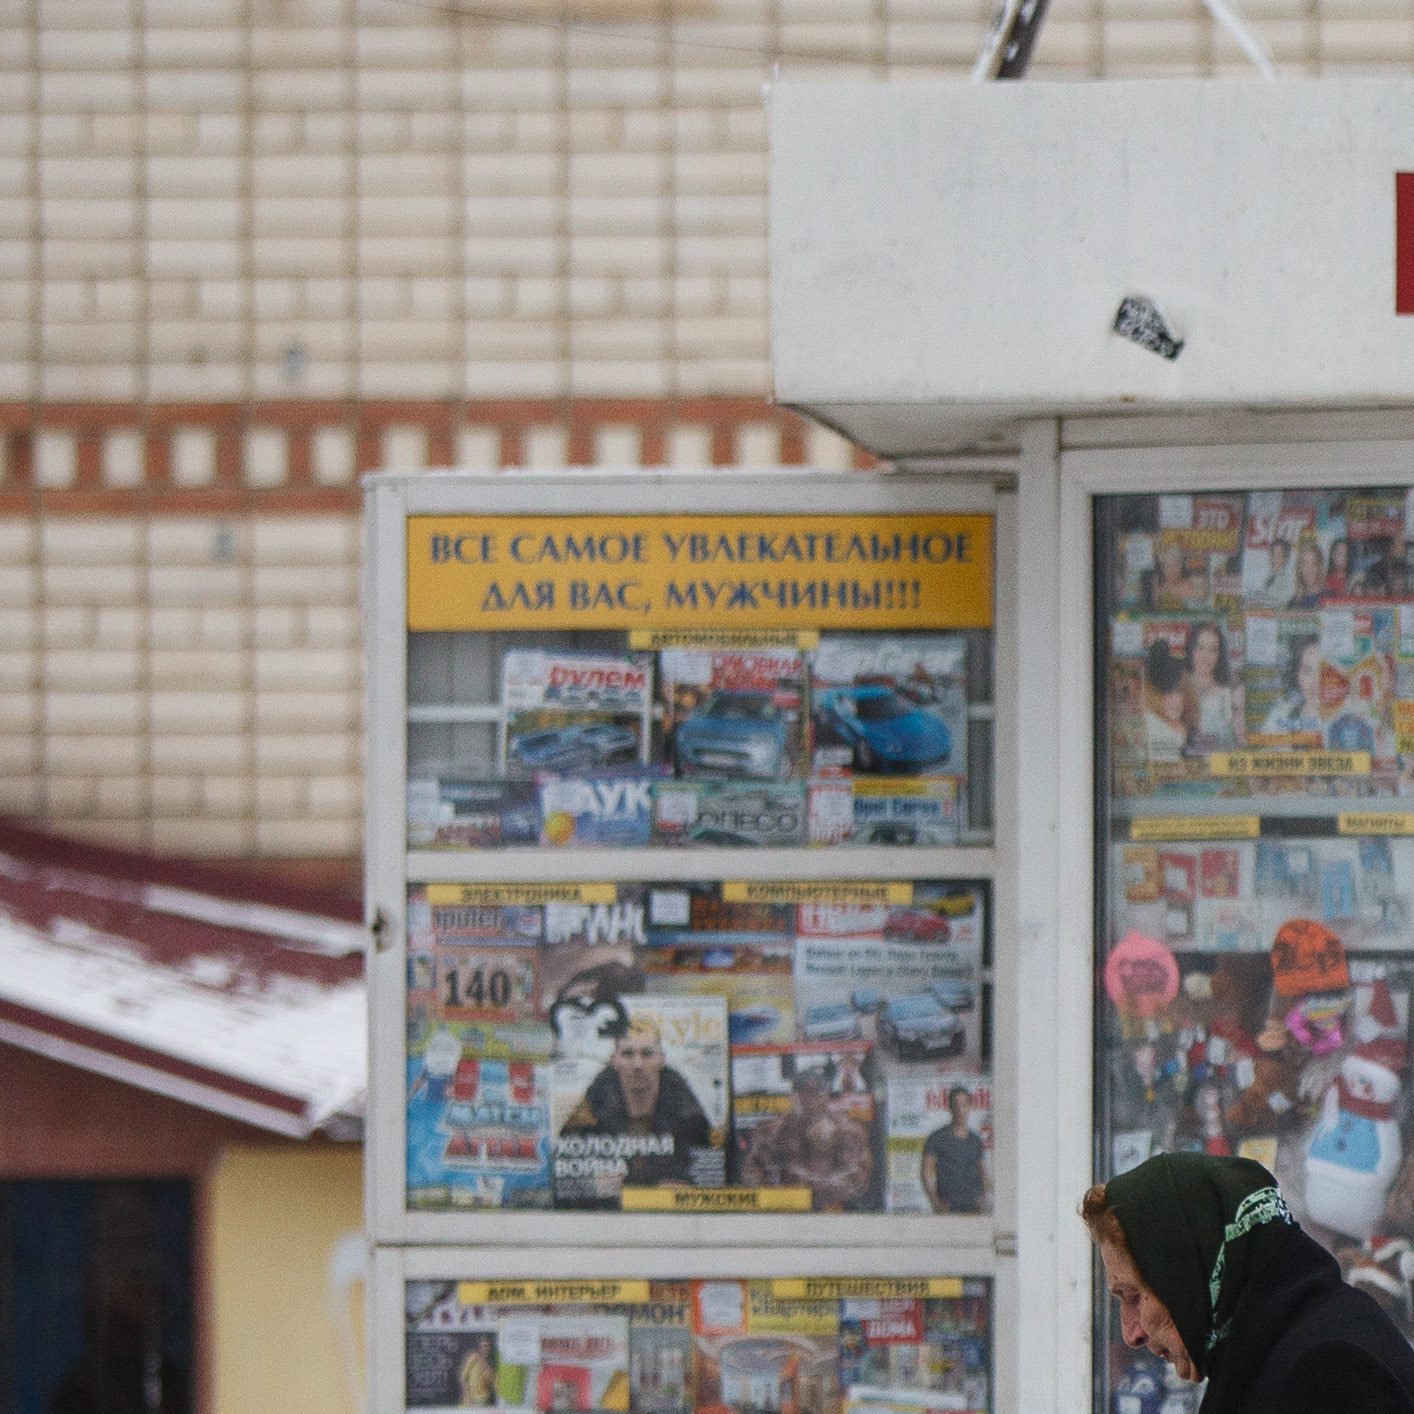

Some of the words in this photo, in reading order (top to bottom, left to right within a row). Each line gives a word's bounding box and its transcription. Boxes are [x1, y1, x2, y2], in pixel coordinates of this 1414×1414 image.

[430, 533, 498, 564] ВСЕ
[510, 533, 648, 564] САМОЕ
[661, 532, 973, 564] УВЛЕКАТЕЛЬНОЕ
[481, 581, 556, 613] ДЛЯ
[570, 581, 651, 615] ВАС,
[665, 579, 922, 612] МУЖЧИНЫ!!!
